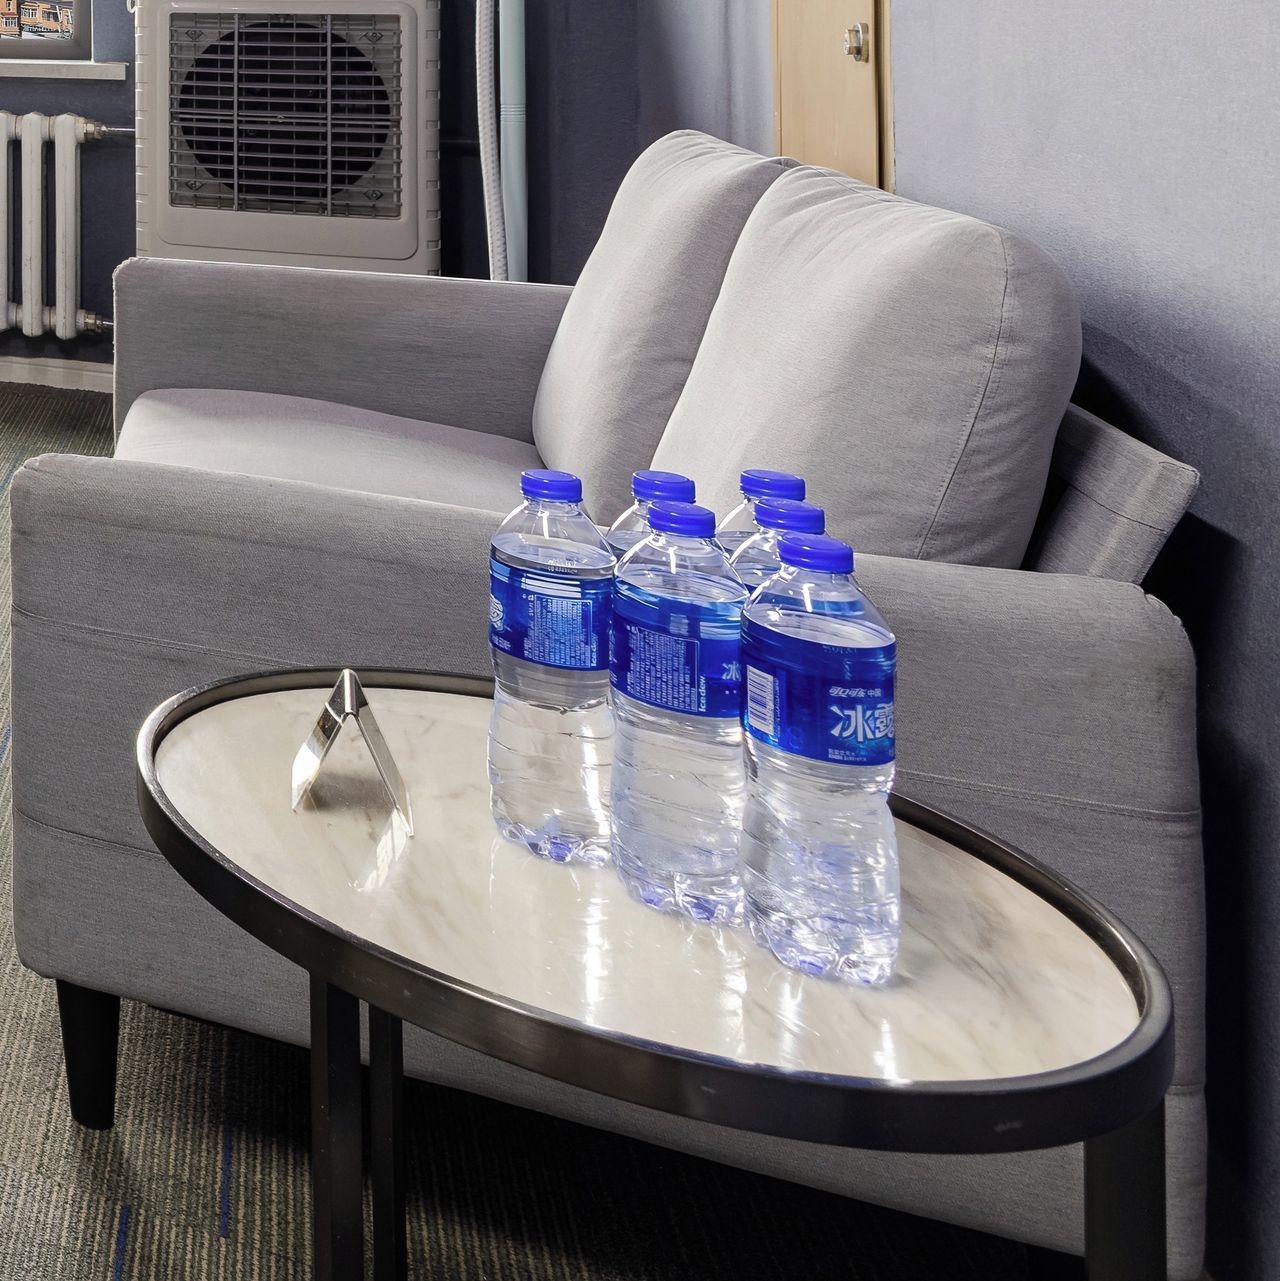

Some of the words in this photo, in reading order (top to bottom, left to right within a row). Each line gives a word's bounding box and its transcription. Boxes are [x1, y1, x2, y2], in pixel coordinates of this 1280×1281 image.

[829, 686, 866, 697] 可口可乐
[867, 688, 882, 697] 中国
